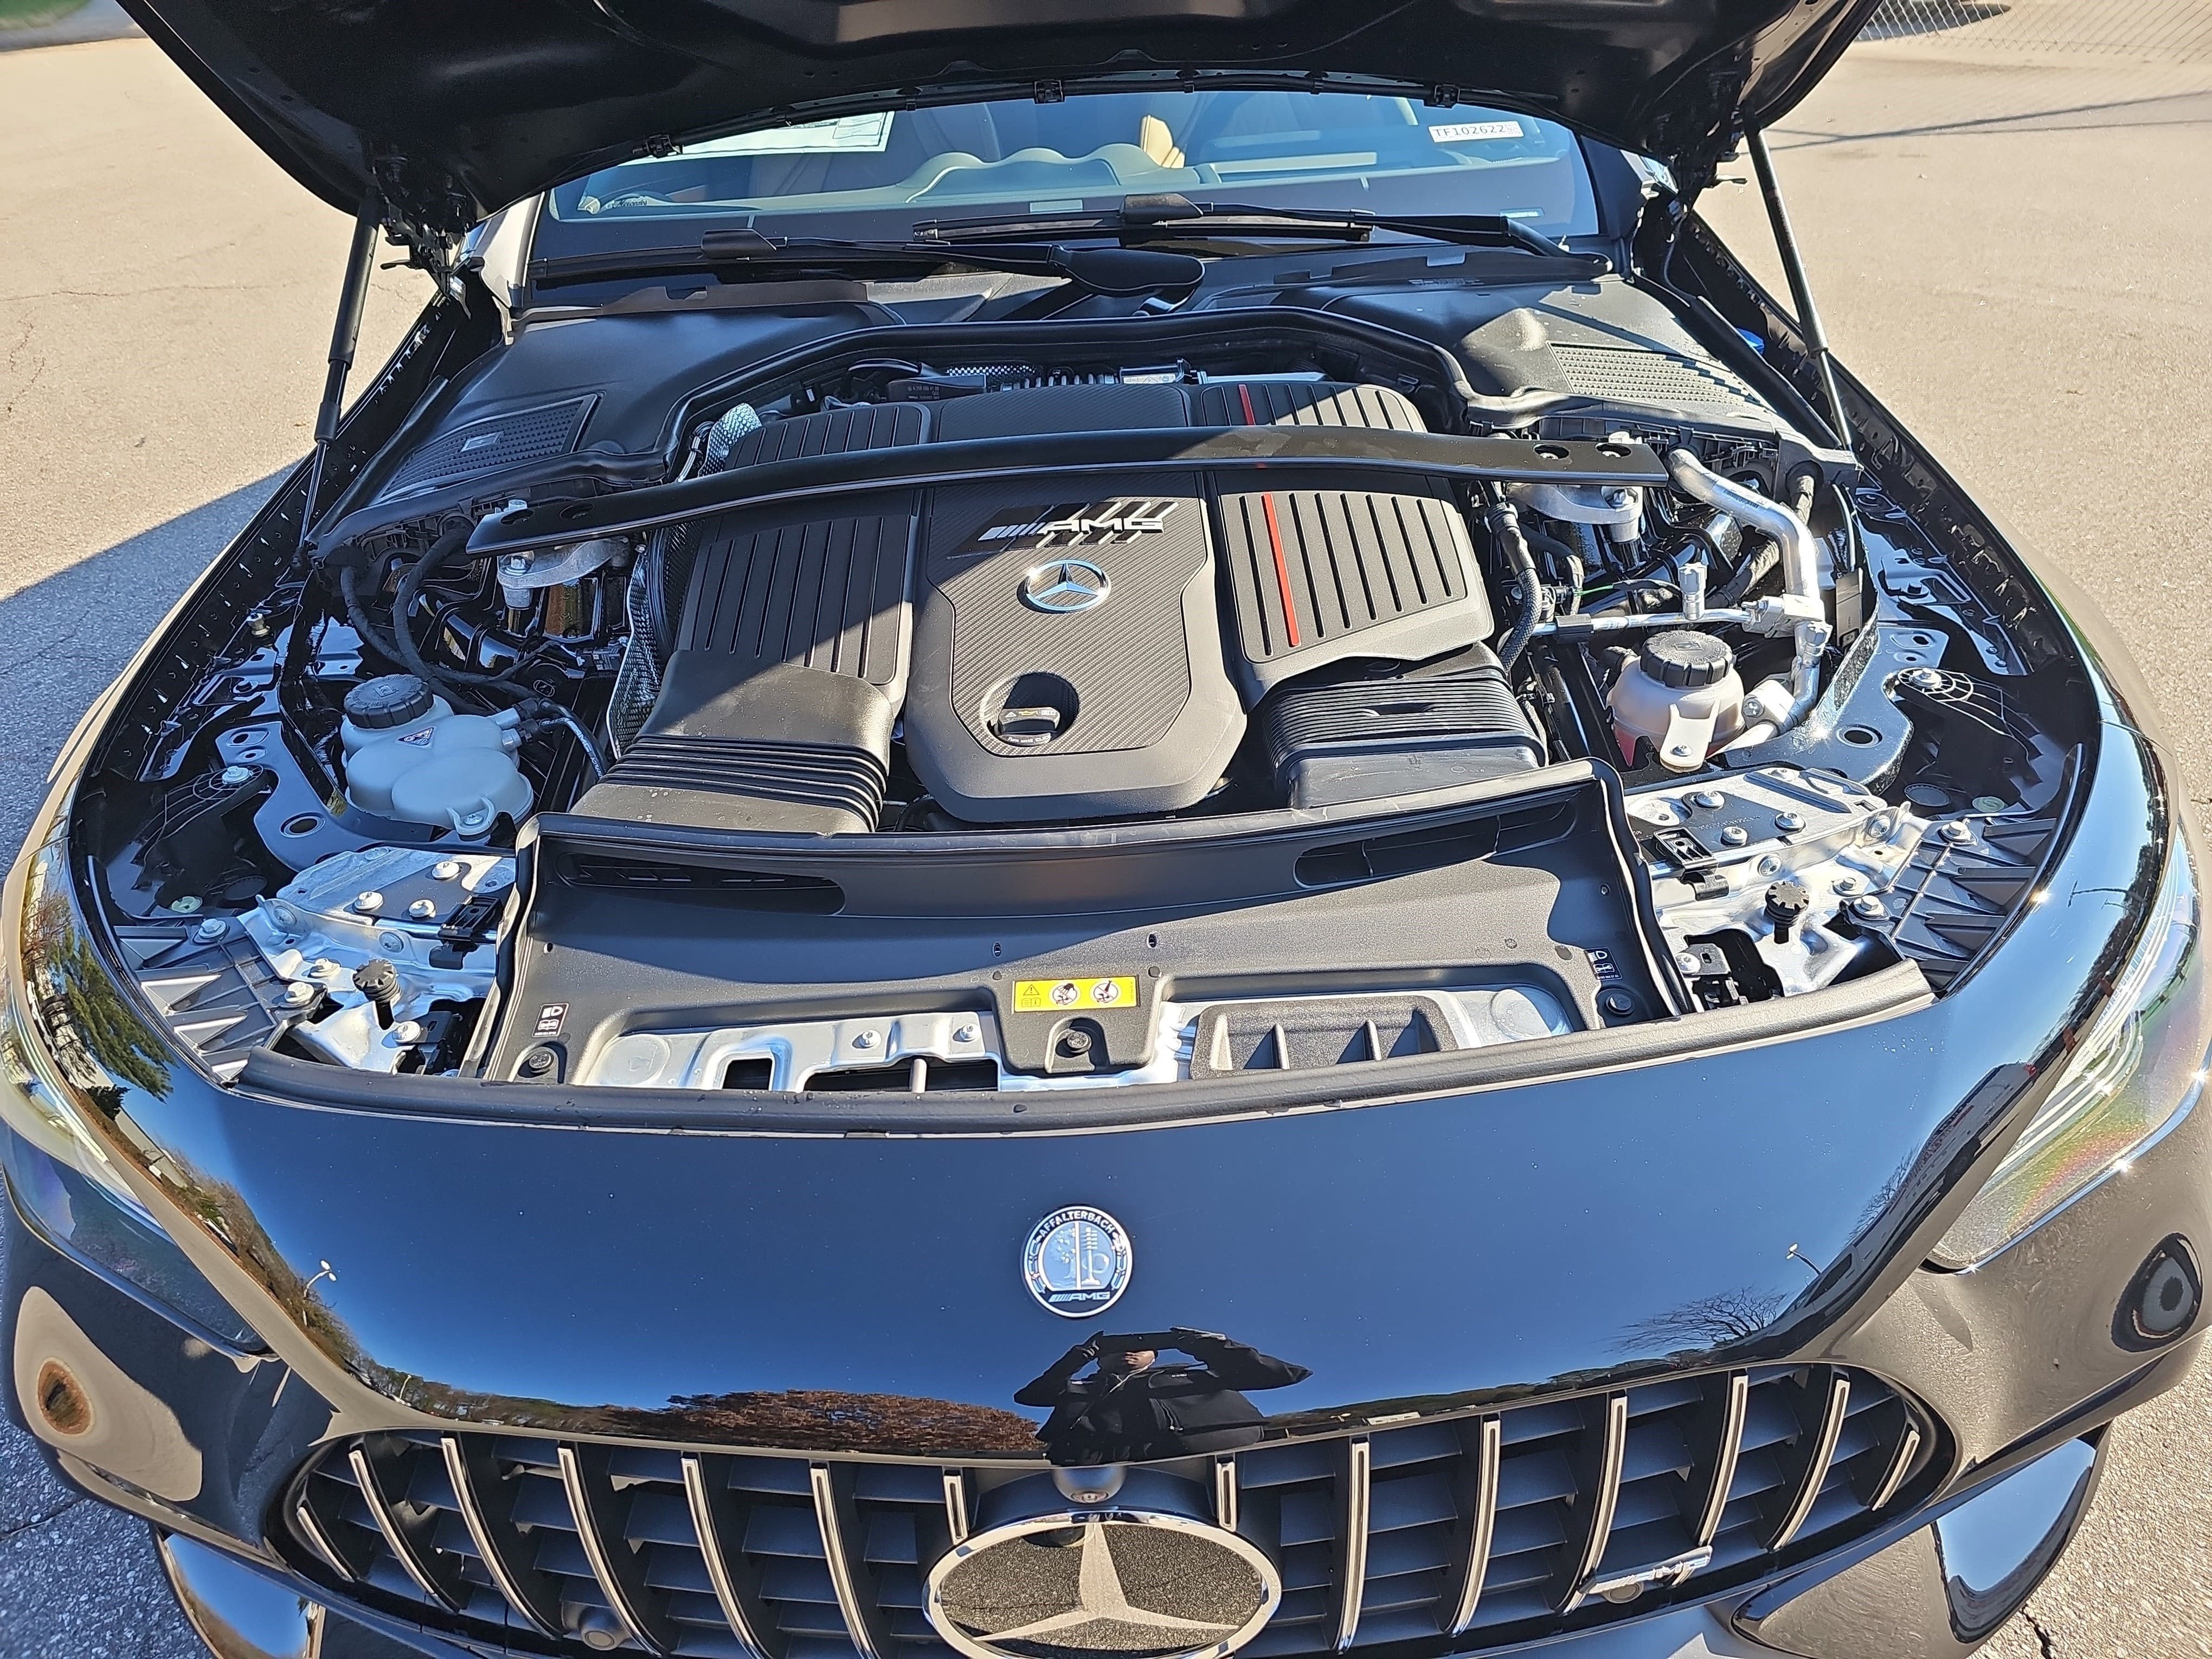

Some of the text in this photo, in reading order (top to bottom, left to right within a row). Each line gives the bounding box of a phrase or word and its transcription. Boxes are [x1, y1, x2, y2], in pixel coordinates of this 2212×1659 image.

[1432, 124, 1506, 137] TF102622
[1036, 517, 1165, 535] AMG
[1039, 1210, 1116, 1238] AFFALTERBACH
[1068, 1291, 1111, 1302] AMG
